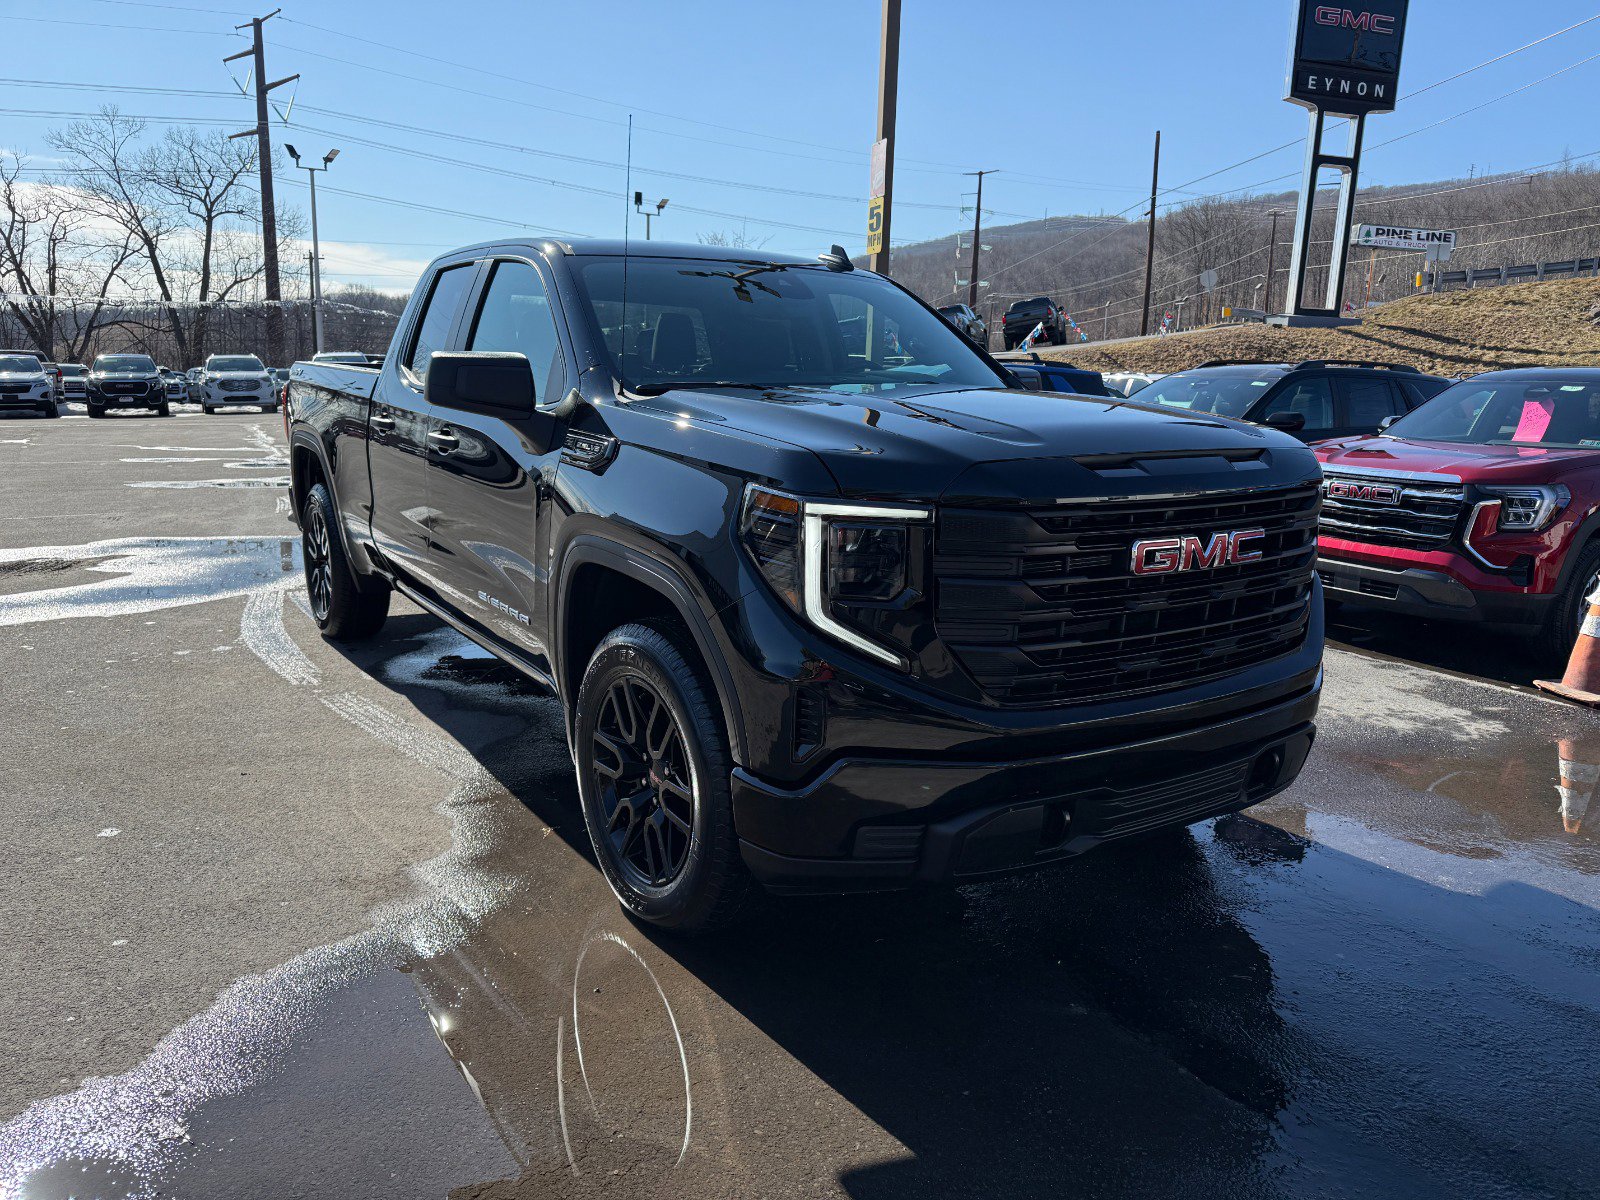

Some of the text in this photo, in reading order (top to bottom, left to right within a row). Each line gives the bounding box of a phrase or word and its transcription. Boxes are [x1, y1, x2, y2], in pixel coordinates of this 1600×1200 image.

[1315, 6, 1395, 34] GMC
[1308, 75, 1385, 98] EYNON
[869, 205, 881, 232] 5
[868, 233, 881, 246] MPH
[1375, 228, 1452, 243] PINE LINE
[1330, 482, 1394, 503] GMC
[1131, 528, 1265, 575] GMC
[478, 590, 530, 626] SIERRA
